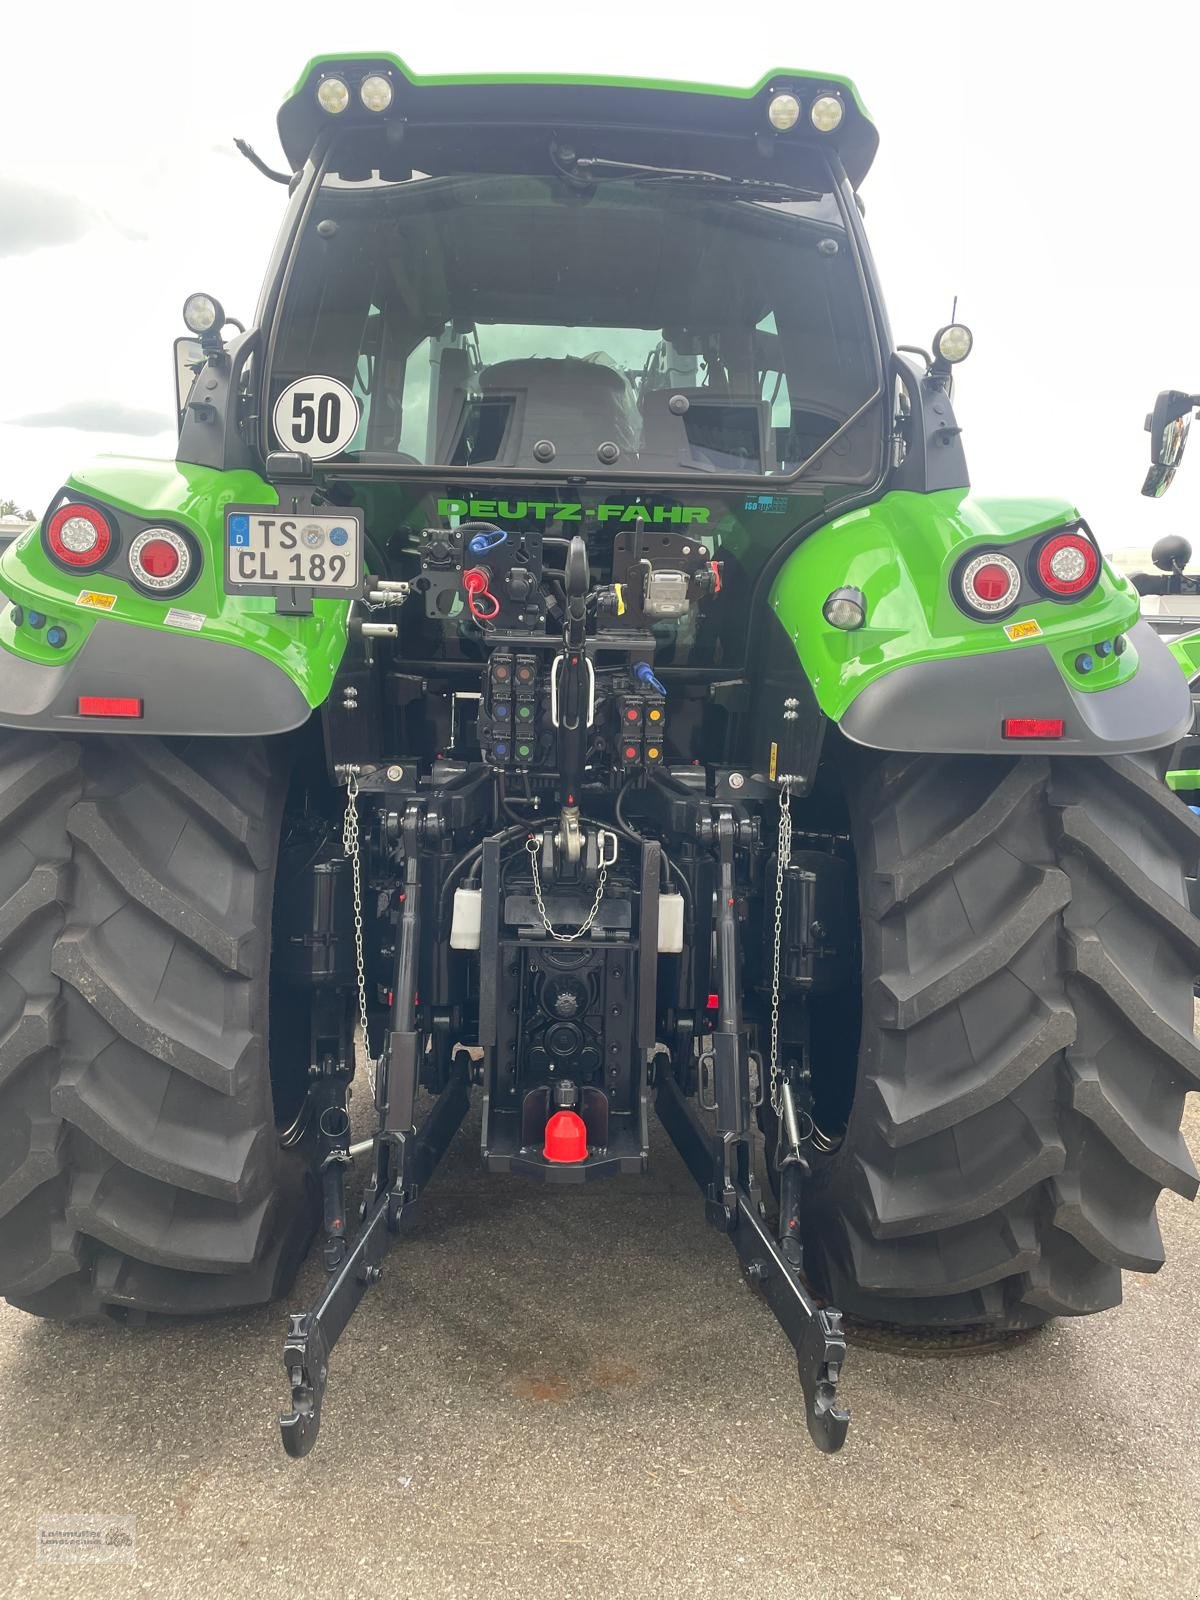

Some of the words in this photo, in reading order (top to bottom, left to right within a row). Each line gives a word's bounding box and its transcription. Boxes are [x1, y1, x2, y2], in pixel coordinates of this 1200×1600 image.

[291, 392, 341, 444] 50
[437, 498, 711, 524] DEUTZ-FAHR
[235, 534, 244, 545] D
[258, 520, 298, 549] TS
[238, 551, 278, 580] CL
[288, 553, 346, 582] 189
